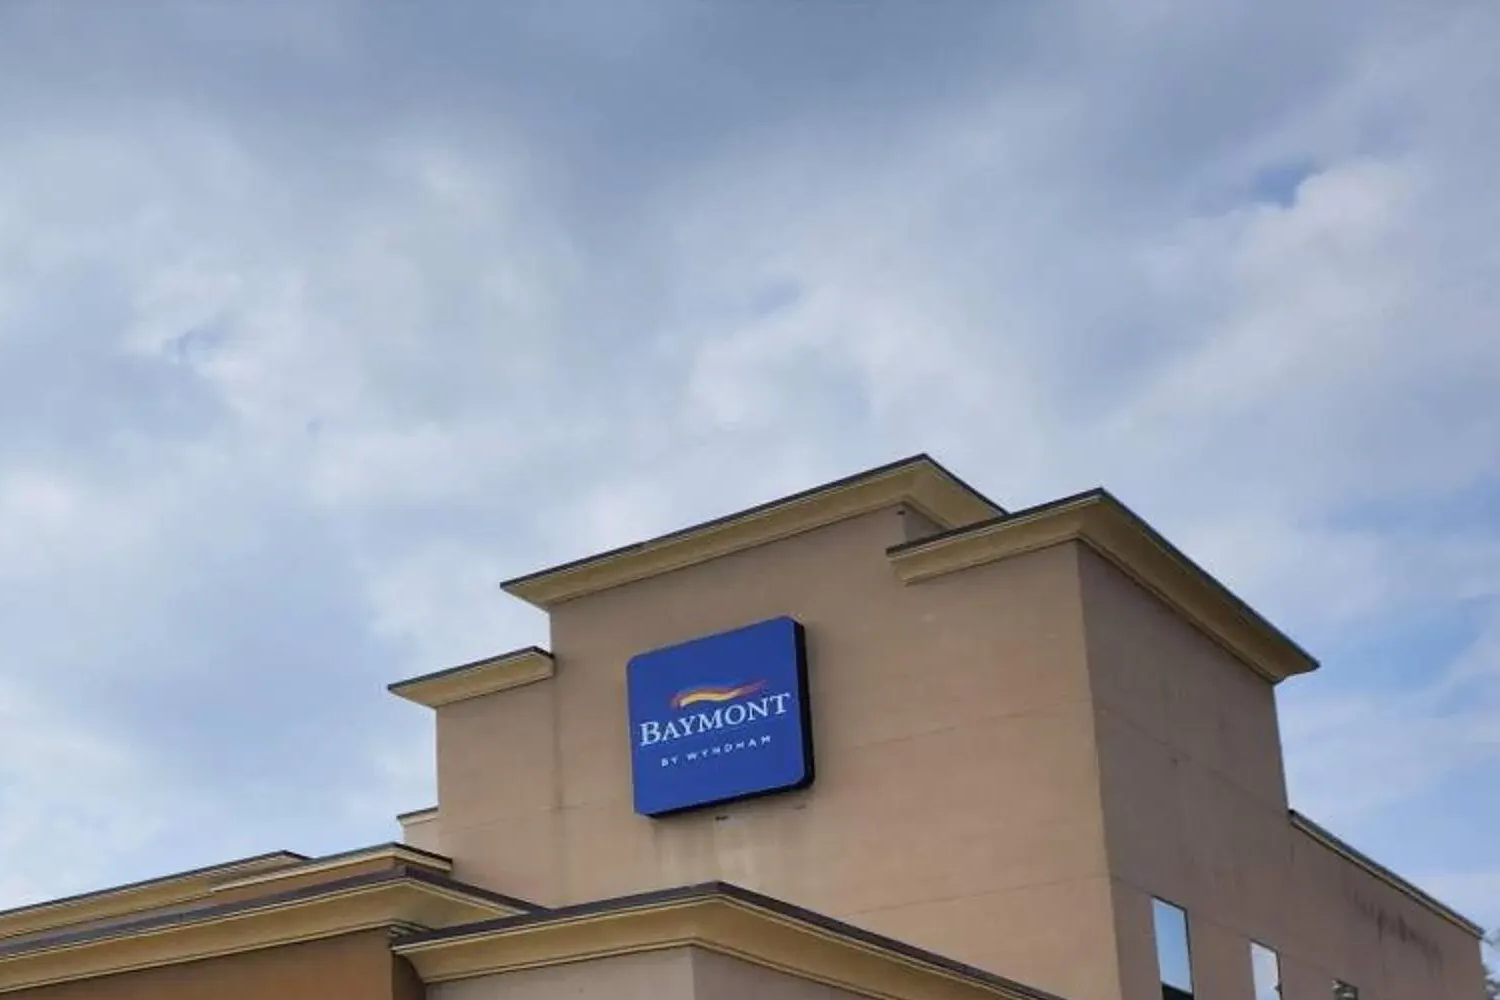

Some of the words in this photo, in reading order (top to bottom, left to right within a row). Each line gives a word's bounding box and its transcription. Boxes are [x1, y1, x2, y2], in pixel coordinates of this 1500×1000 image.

[639, 692, 791, 747] BAYMONT
[660, 755, 679, 767] BY
[686, 735, 772, 761] WYNDHAM
